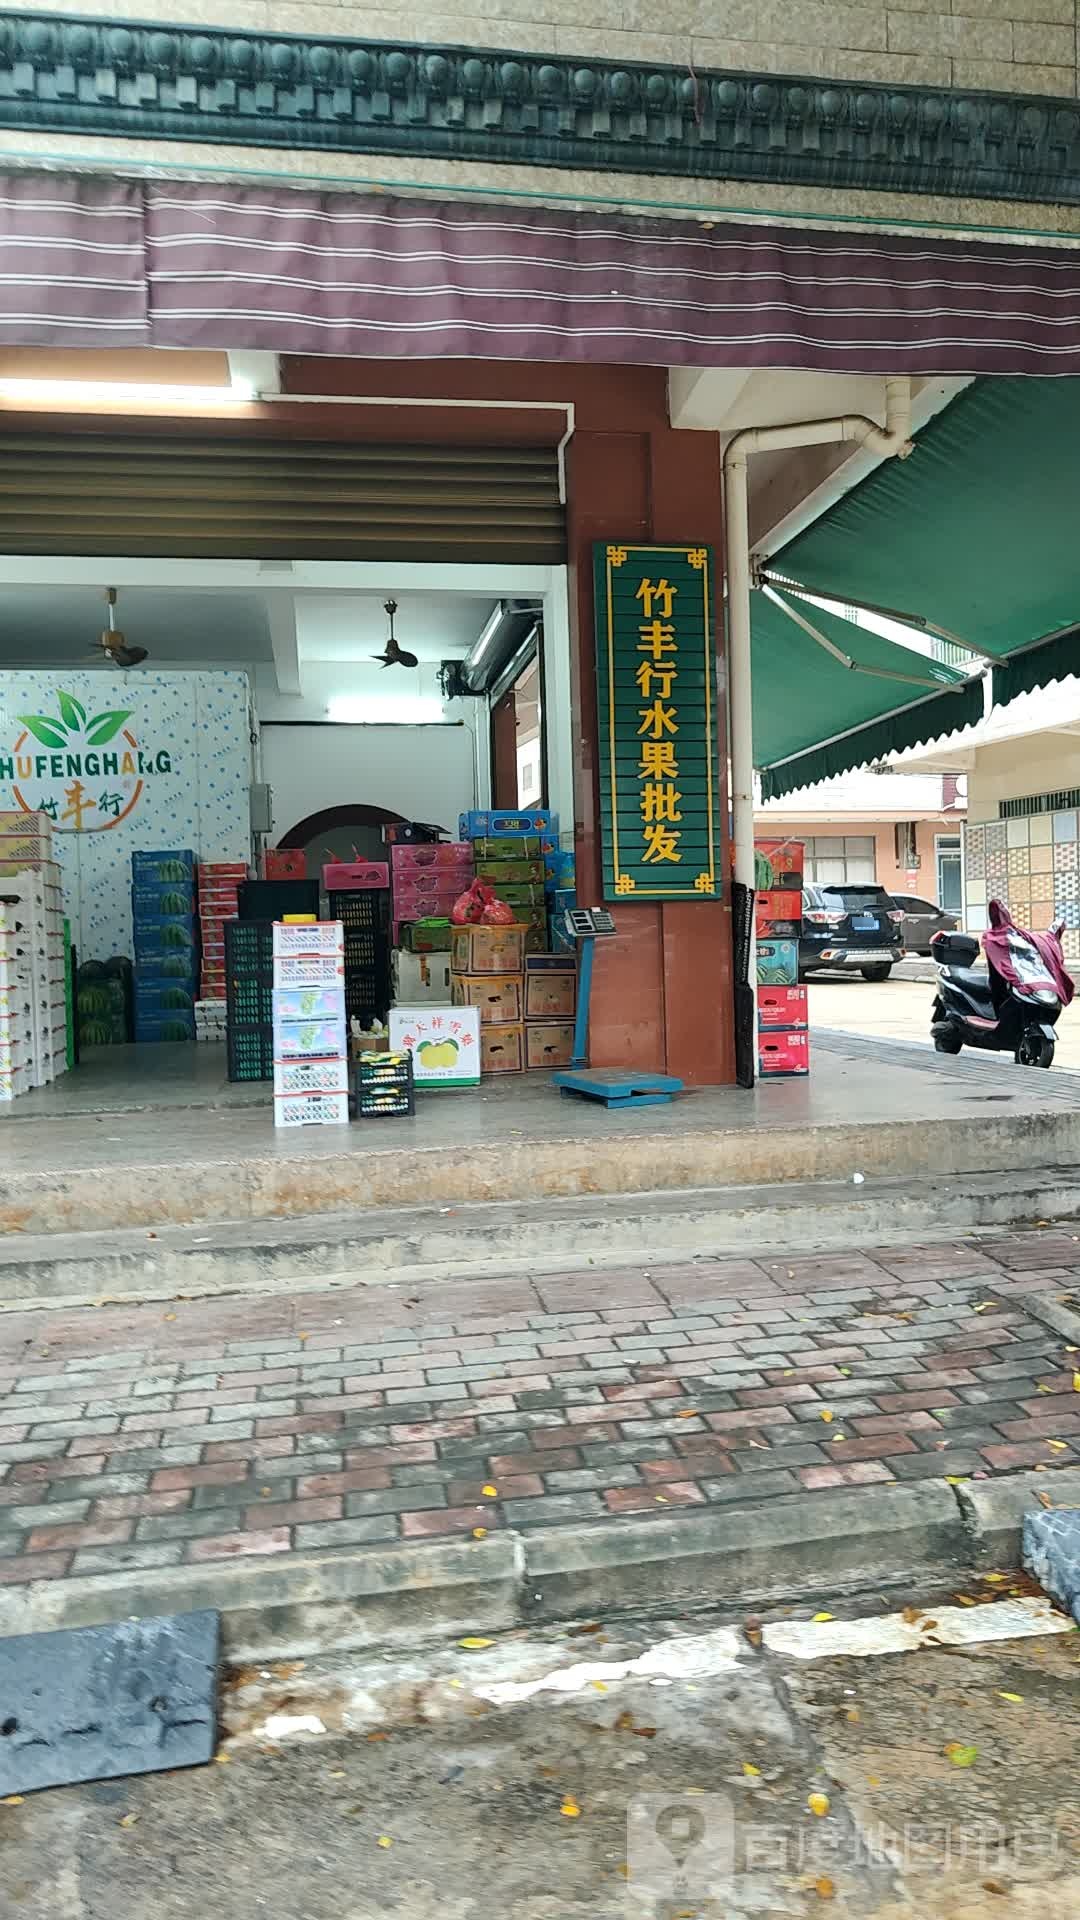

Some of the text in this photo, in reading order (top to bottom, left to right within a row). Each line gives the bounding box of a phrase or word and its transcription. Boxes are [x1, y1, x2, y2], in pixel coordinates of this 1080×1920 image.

[635, 577, 683, 863] 竹丰行水果批发
